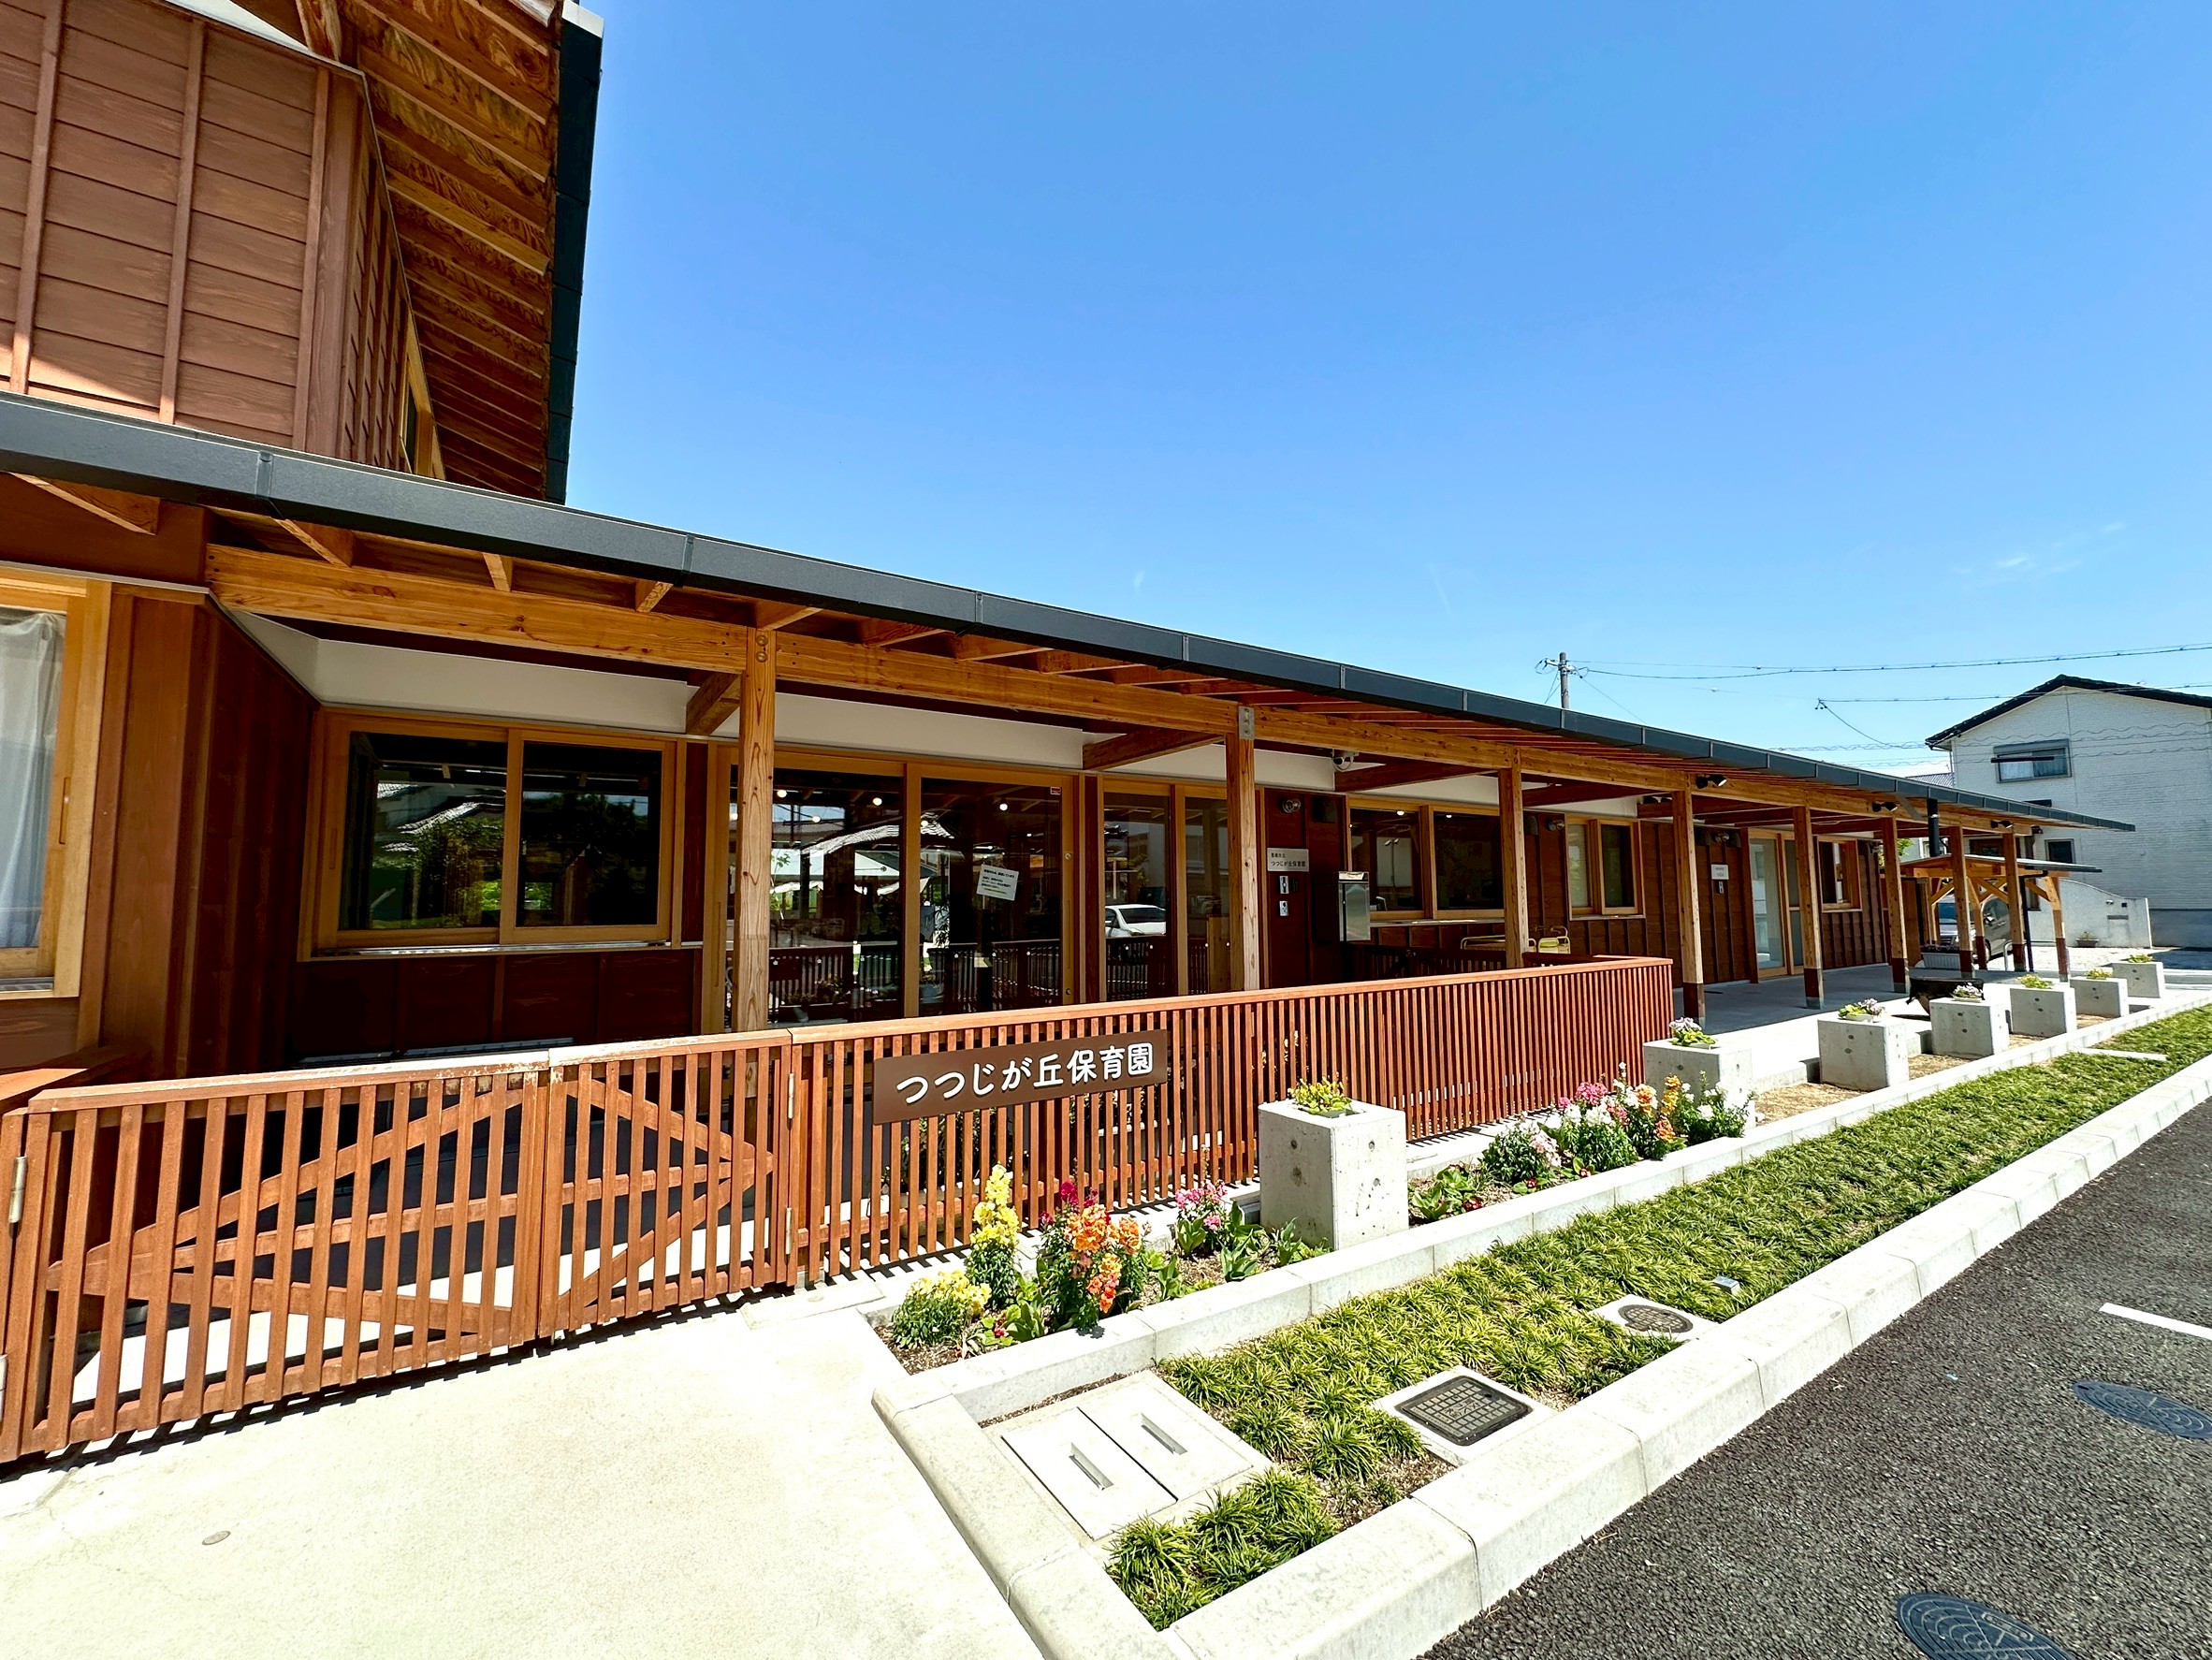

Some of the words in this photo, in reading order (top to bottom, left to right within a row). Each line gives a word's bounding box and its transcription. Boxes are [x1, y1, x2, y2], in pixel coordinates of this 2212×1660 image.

[895, 1041, 1154, 1105] つつじが丘保育園
